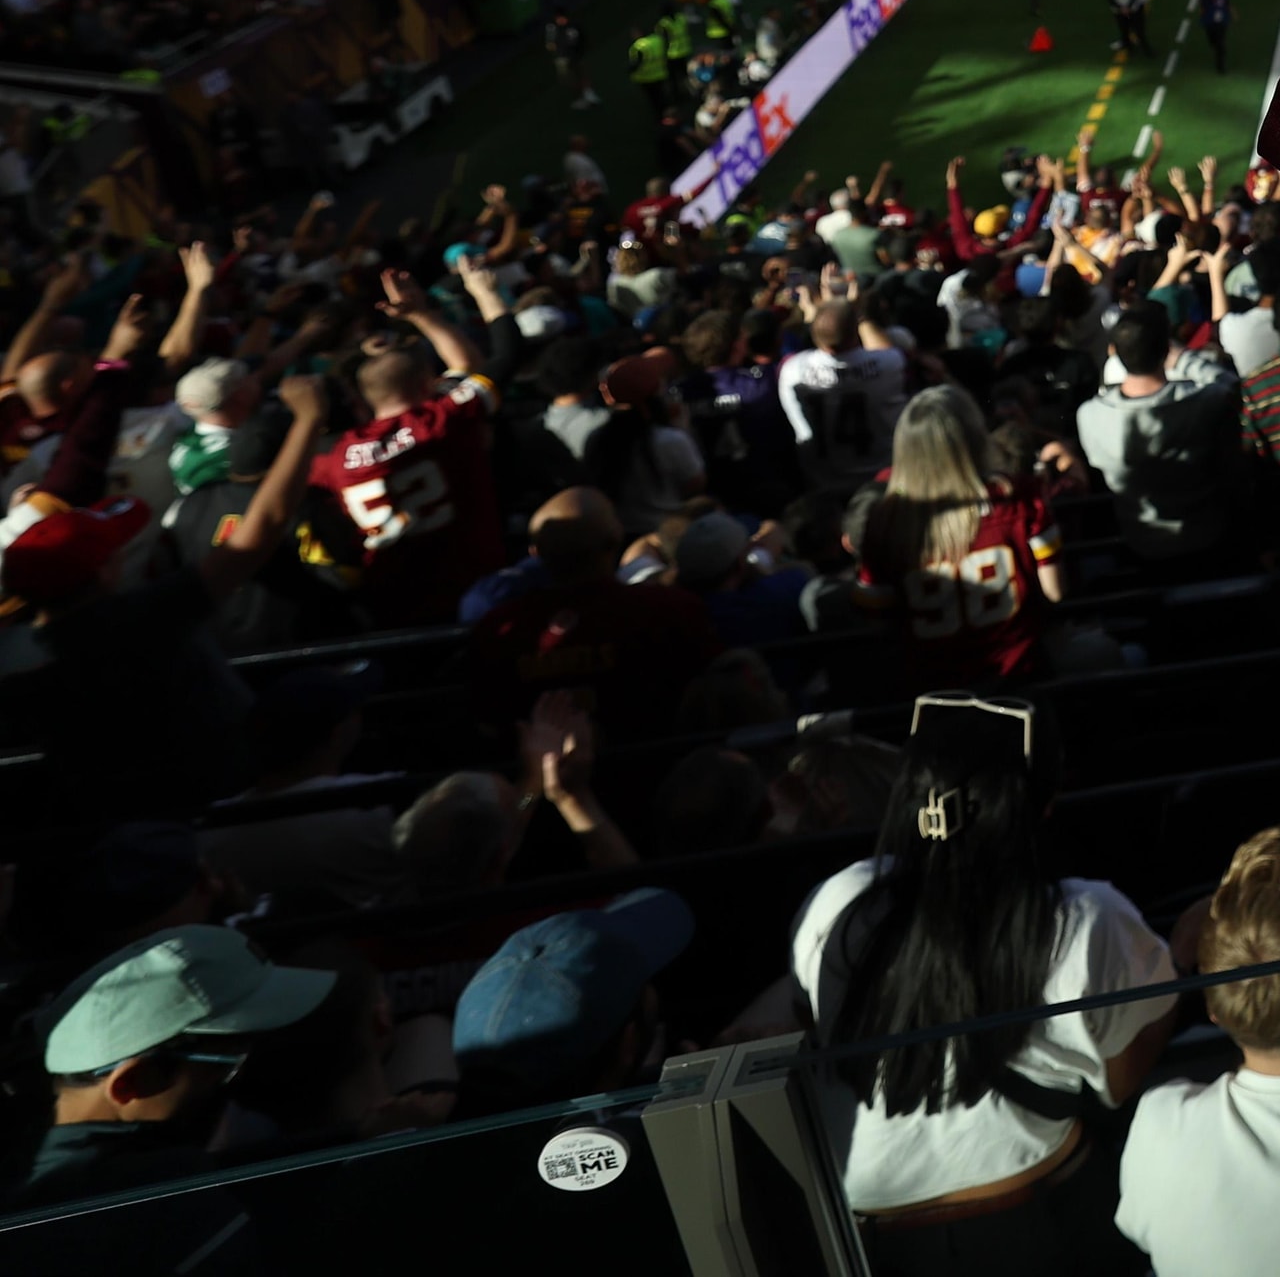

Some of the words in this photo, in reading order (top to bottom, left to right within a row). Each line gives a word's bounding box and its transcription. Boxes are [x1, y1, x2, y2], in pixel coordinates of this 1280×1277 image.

[342, 459, 458, 552] 52
[902, 543, 1021, 641] 98
[578, 1149, 616, 1162] SCAN
[580, 1156, 619, 1175] ME
